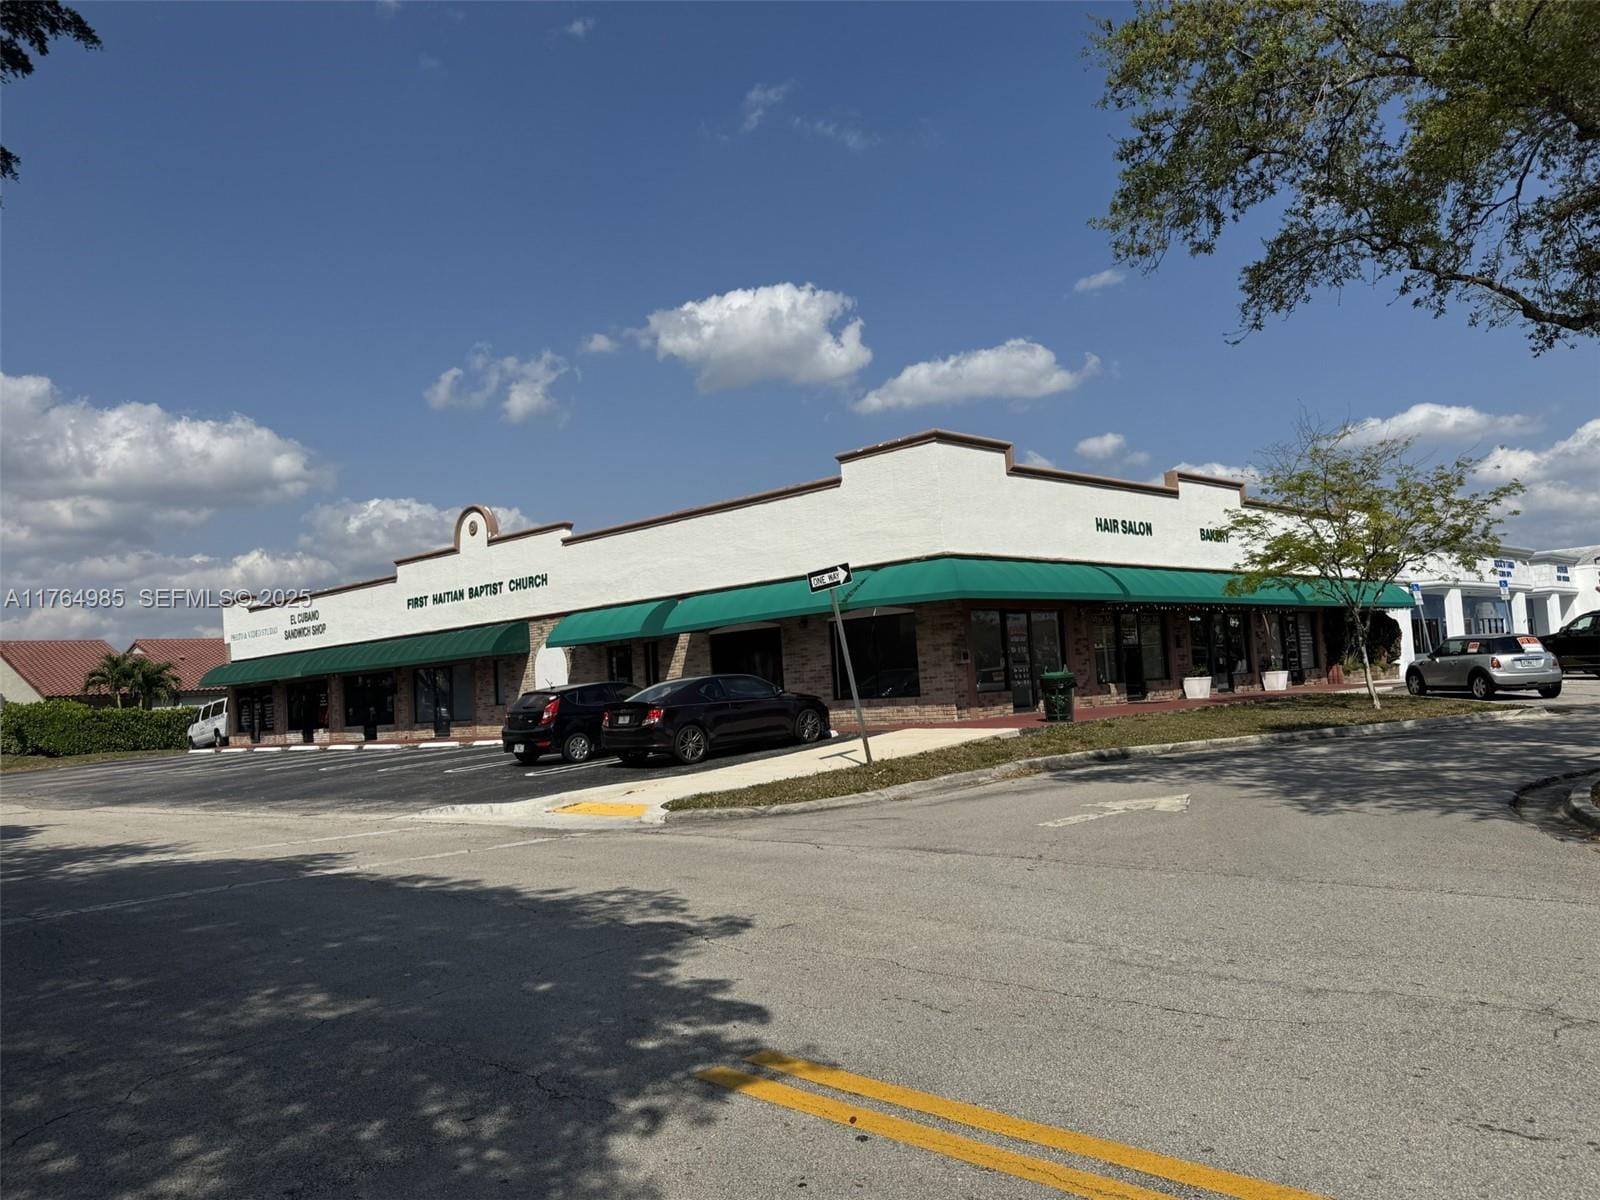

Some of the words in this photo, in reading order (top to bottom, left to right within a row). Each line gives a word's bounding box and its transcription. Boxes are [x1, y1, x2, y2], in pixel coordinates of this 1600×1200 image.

[1095, 517, 1119, 534] HAIR
[1120, 519, 1153, 537] SALON
[813, 575, 826, 585] ONE
[828, 572, 840, 581] WAY
[407, 596, 428, 610] FIRST
[432, 588, 465, 606] HAITIAN
[468, 581, 503, 599] BAPTIST
[508, 573, 548, 592] CHURCH
[290, 614, 297, 625] EL
[297, 609, 320, 624] CUBANO
[284, 626, 312, 641] SANDWICH
[311, 623, 327, 636] SHOP
